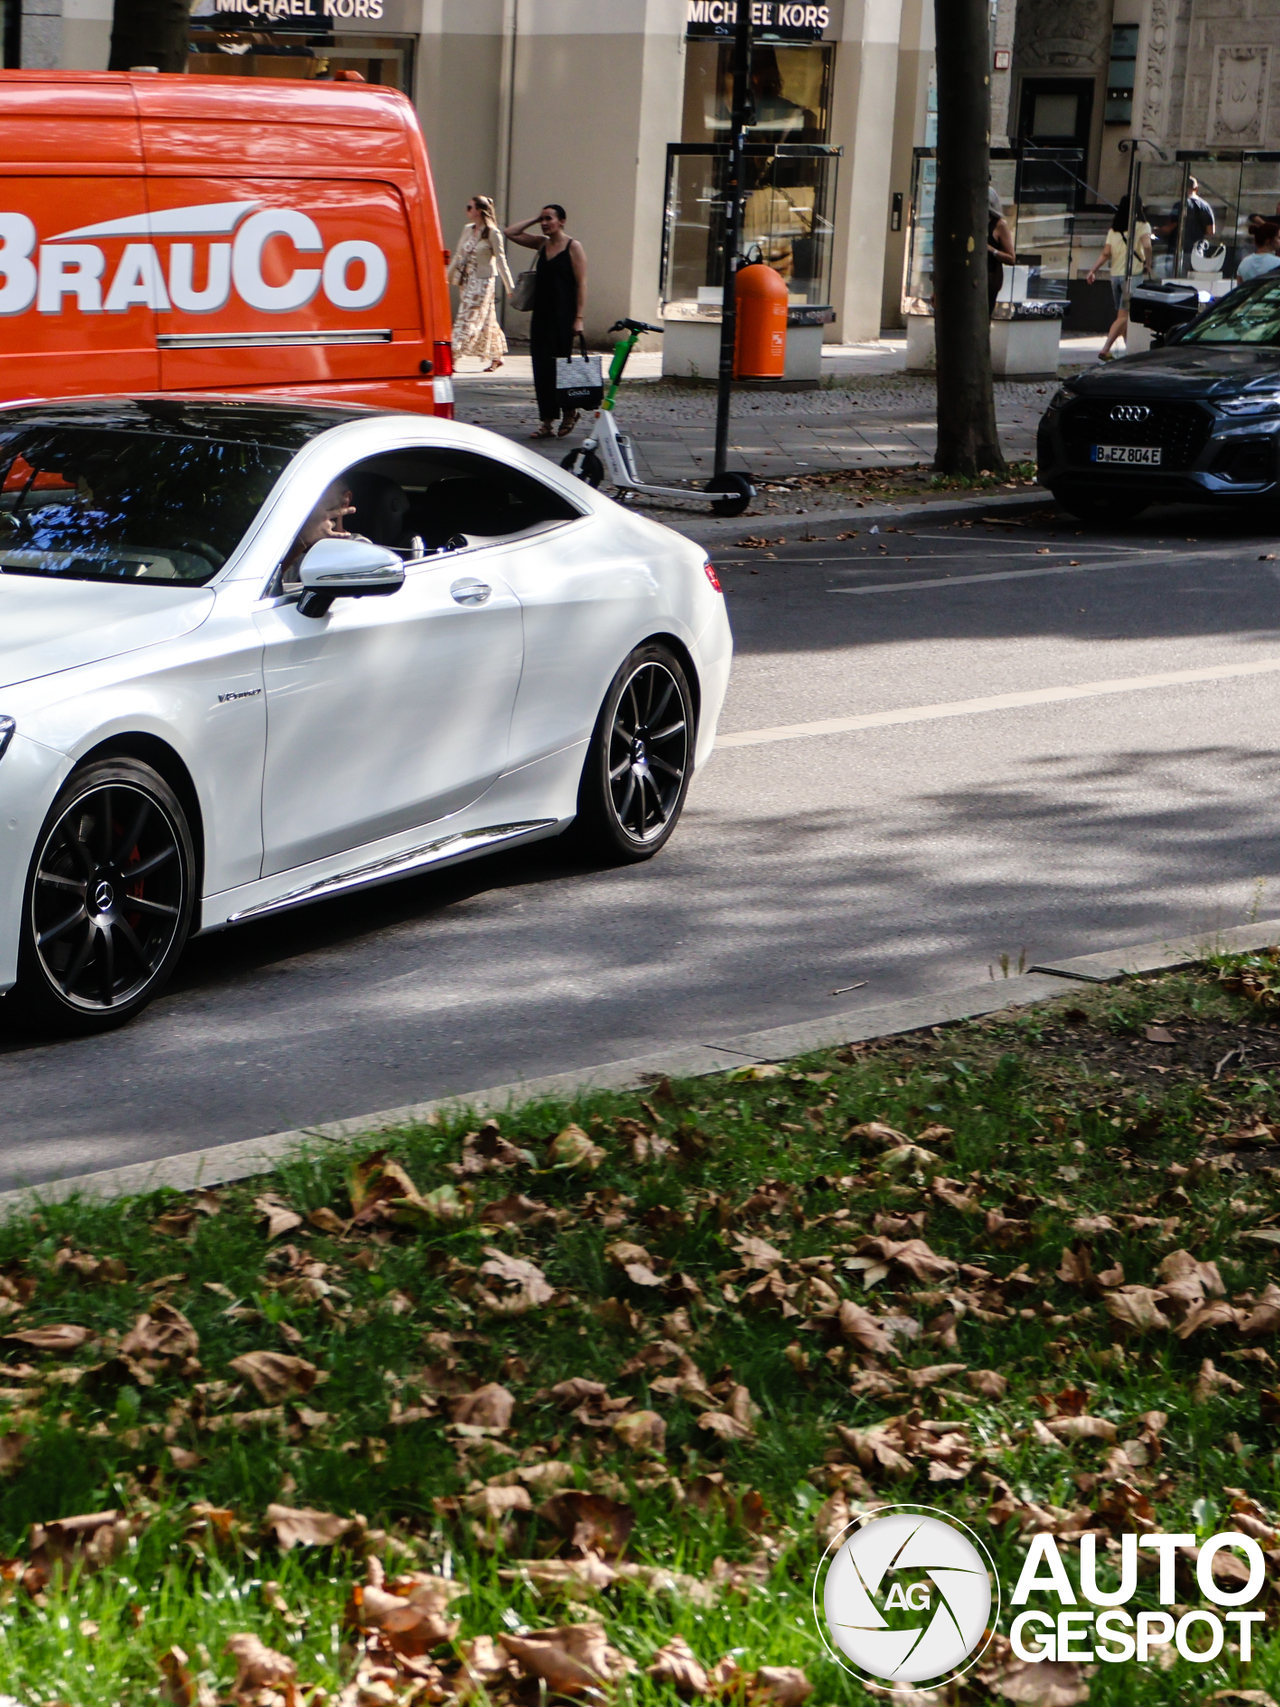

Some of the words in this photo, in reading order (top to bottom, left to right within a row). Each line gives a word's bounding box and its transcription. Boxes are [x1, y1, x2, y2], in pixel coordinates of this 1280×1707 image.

[322, 0, 384, 19] KORS
[687, 0, 772, 25] MICHEL
[778, 4, 829, 28] KORS
[1097, 447, 1104, 461] B
[1111, 448, 1126, 462] EZ
